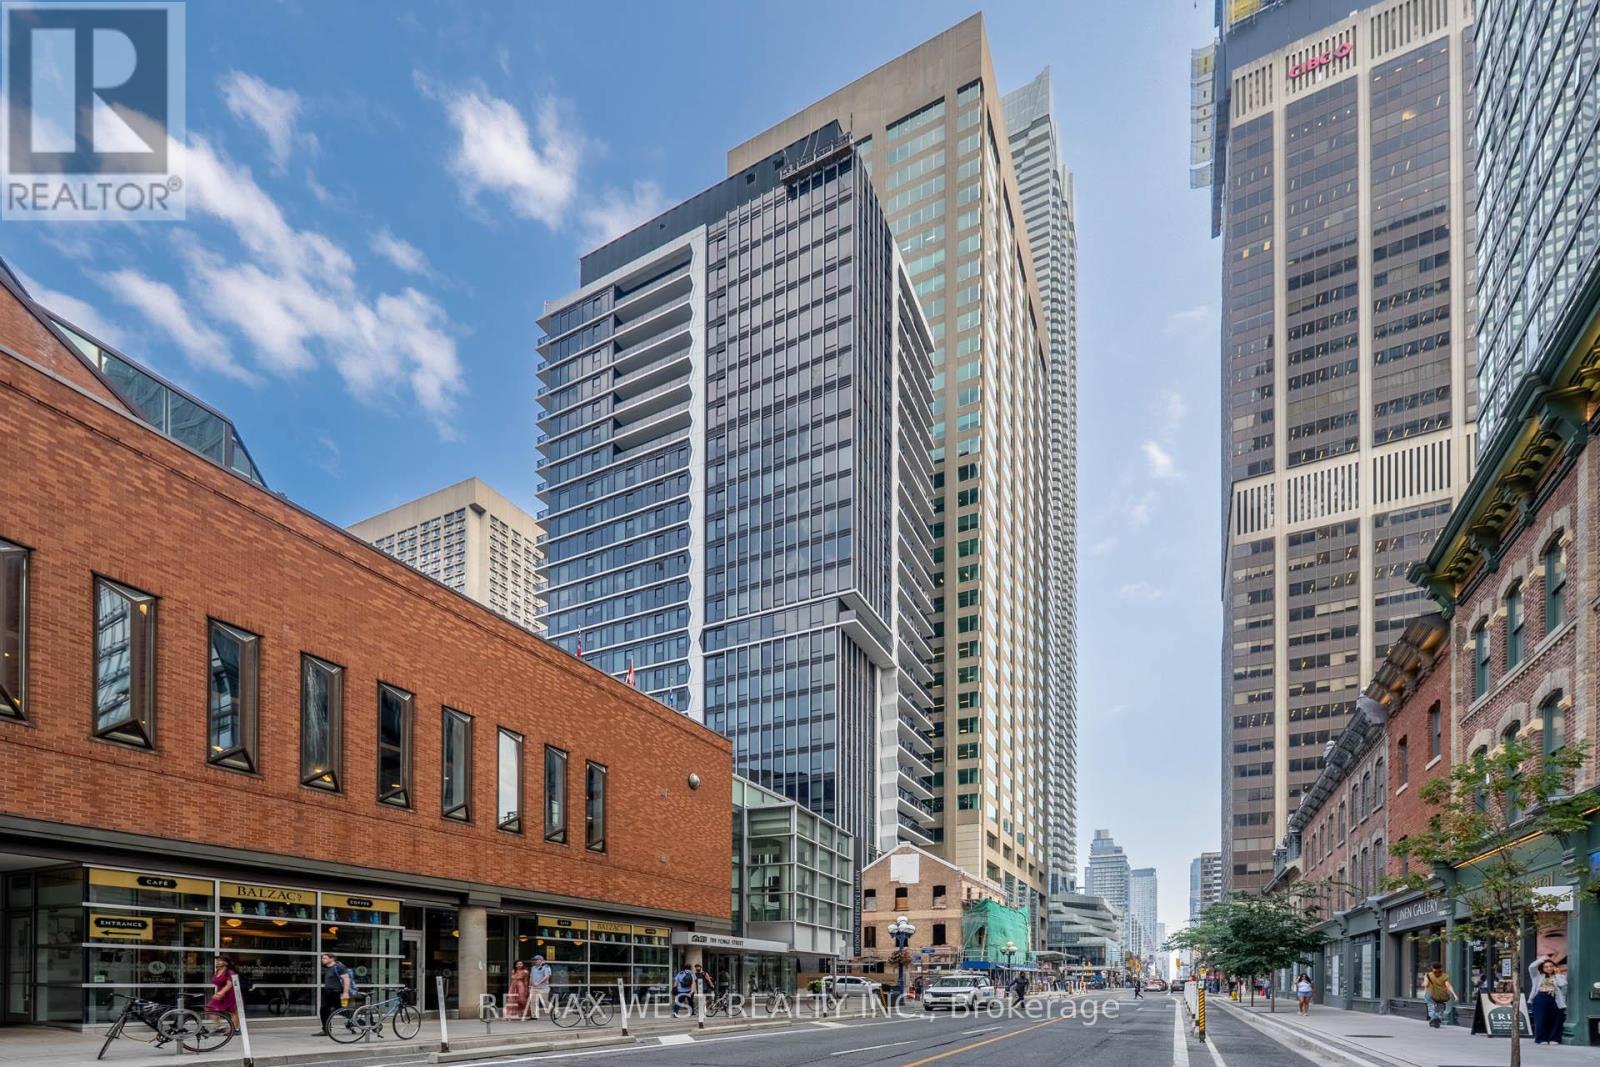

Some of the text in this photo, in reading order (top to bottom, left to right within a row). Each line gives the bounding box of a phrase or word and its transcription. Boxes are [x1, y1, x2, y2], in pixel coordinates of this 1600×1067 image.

[1289, 50, 1331, 78] CIBC
[1413, 898, 1439, 917] GALLERY
[100, 920, 143, 928] ENTRANCE
